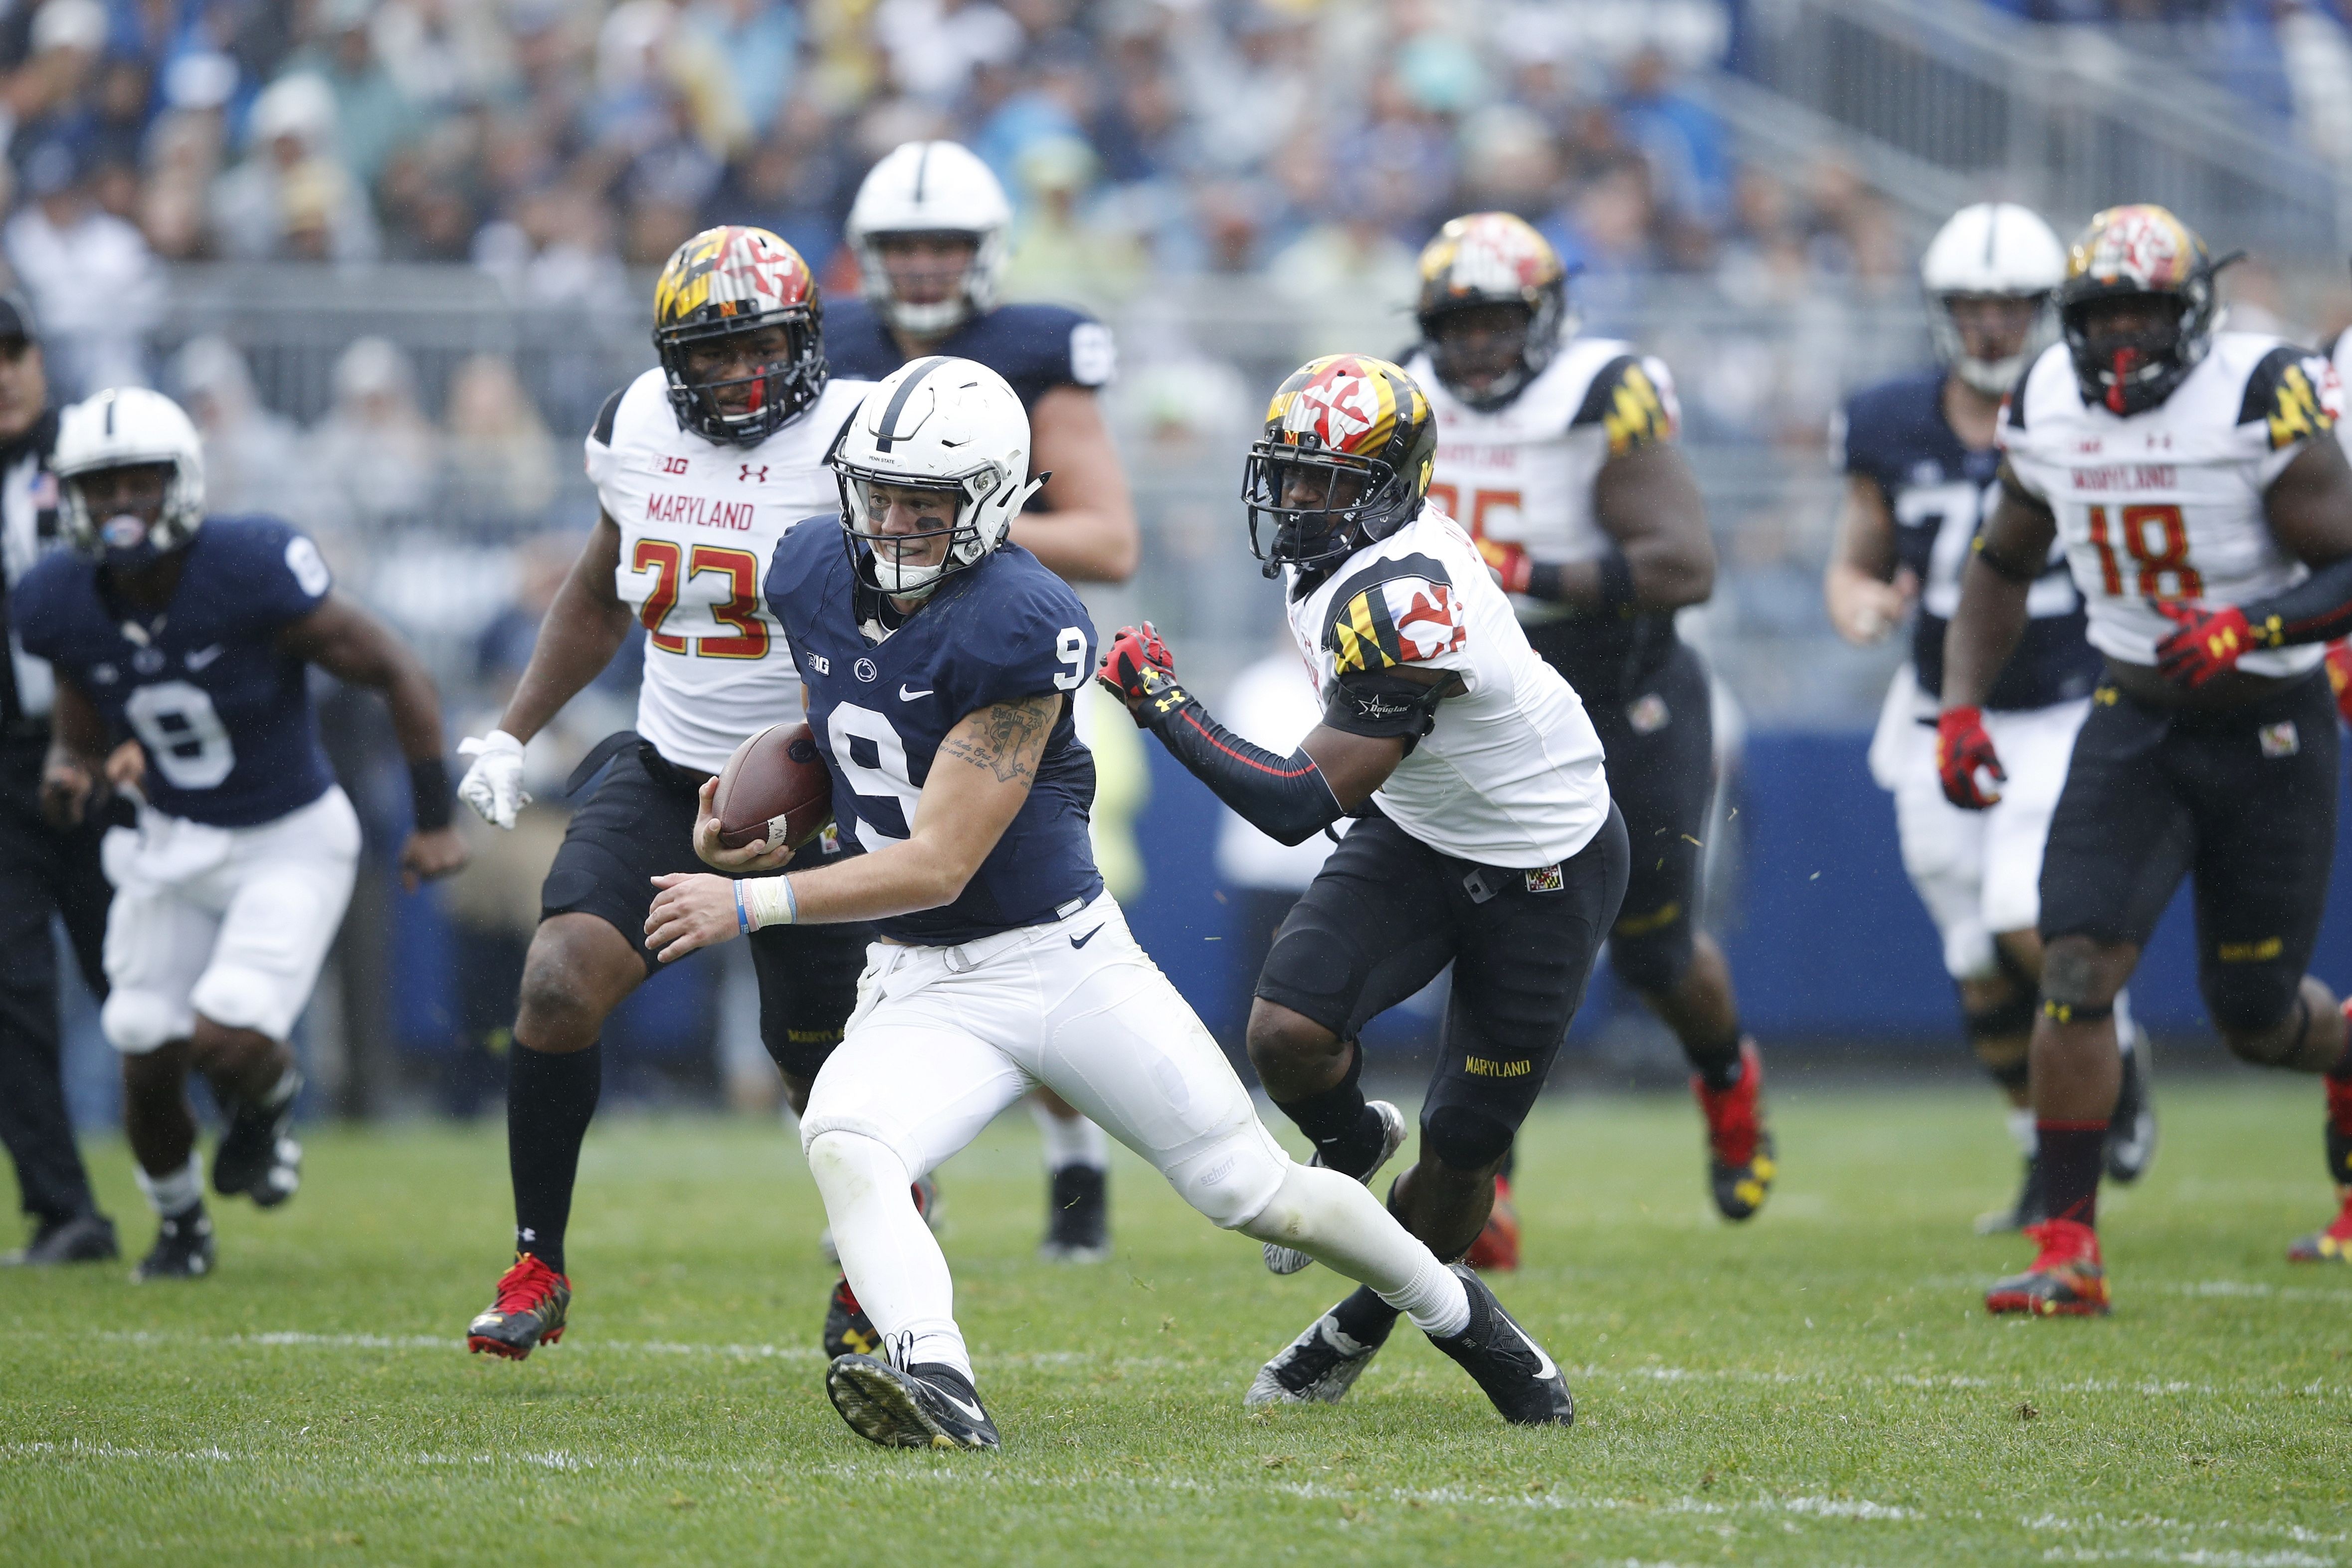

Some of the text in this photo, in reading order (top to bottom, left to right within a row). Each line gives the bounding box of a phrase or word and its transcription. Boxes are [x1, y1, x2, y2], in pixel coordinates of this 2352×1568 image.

[1284, 430, 1299, 445] M
[646, 492, 755, 532] MARYLAND
[2088, 503, 2203, 601] 18
[631, 538, 770, 659] 23
[1053, 626, 1088, 690] 9
[990, 706, 1024, 724] Psalm
[1370, 704, 1408, 714] Douglas
[125, 680, 236, 789] 8
[974, 747, 992, 760] Cruz
[827, 700, 923, 853] 9
[1465, 1054, 1531, 1078] MARYLAND
[1200, 1156, 1236, 1185] schutt
